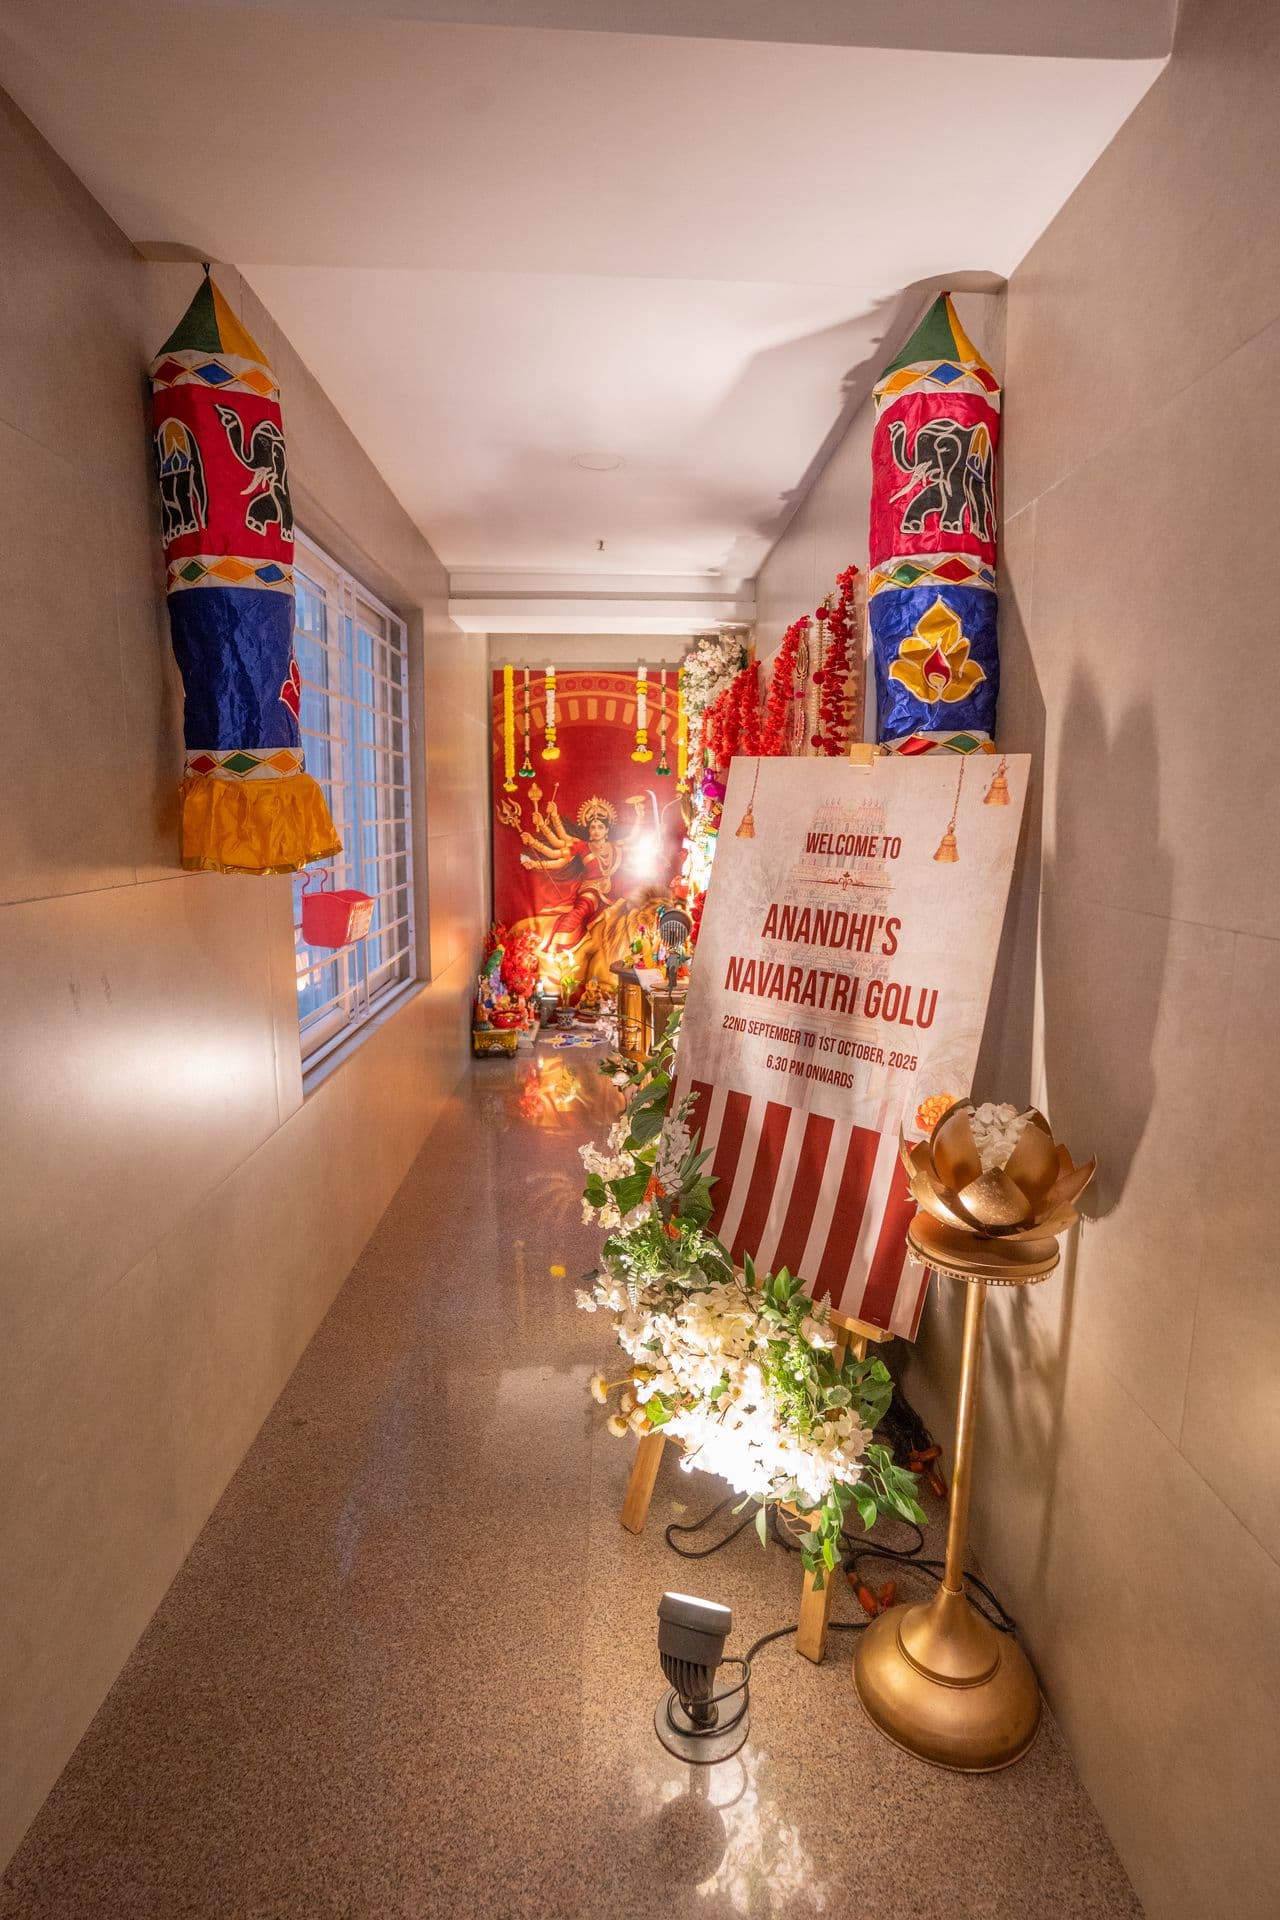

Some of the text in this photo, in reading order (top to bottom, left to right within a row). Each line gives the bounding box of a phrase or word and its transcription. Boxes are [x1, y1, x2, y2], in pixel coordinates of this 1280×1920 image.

[805, 831, 902, 860] WELCOME TO
[761, 903, 901, 956] ANANDHI'S
[724, 956, 939, 1029] NAVARATRI GOLU
[722, 1015, 917, 1072] 22ND SEPTEMBER TO 1ST OCTOBER, 2025
[766, 1054, 854, 1089] 6.30 PM ONWARDS
